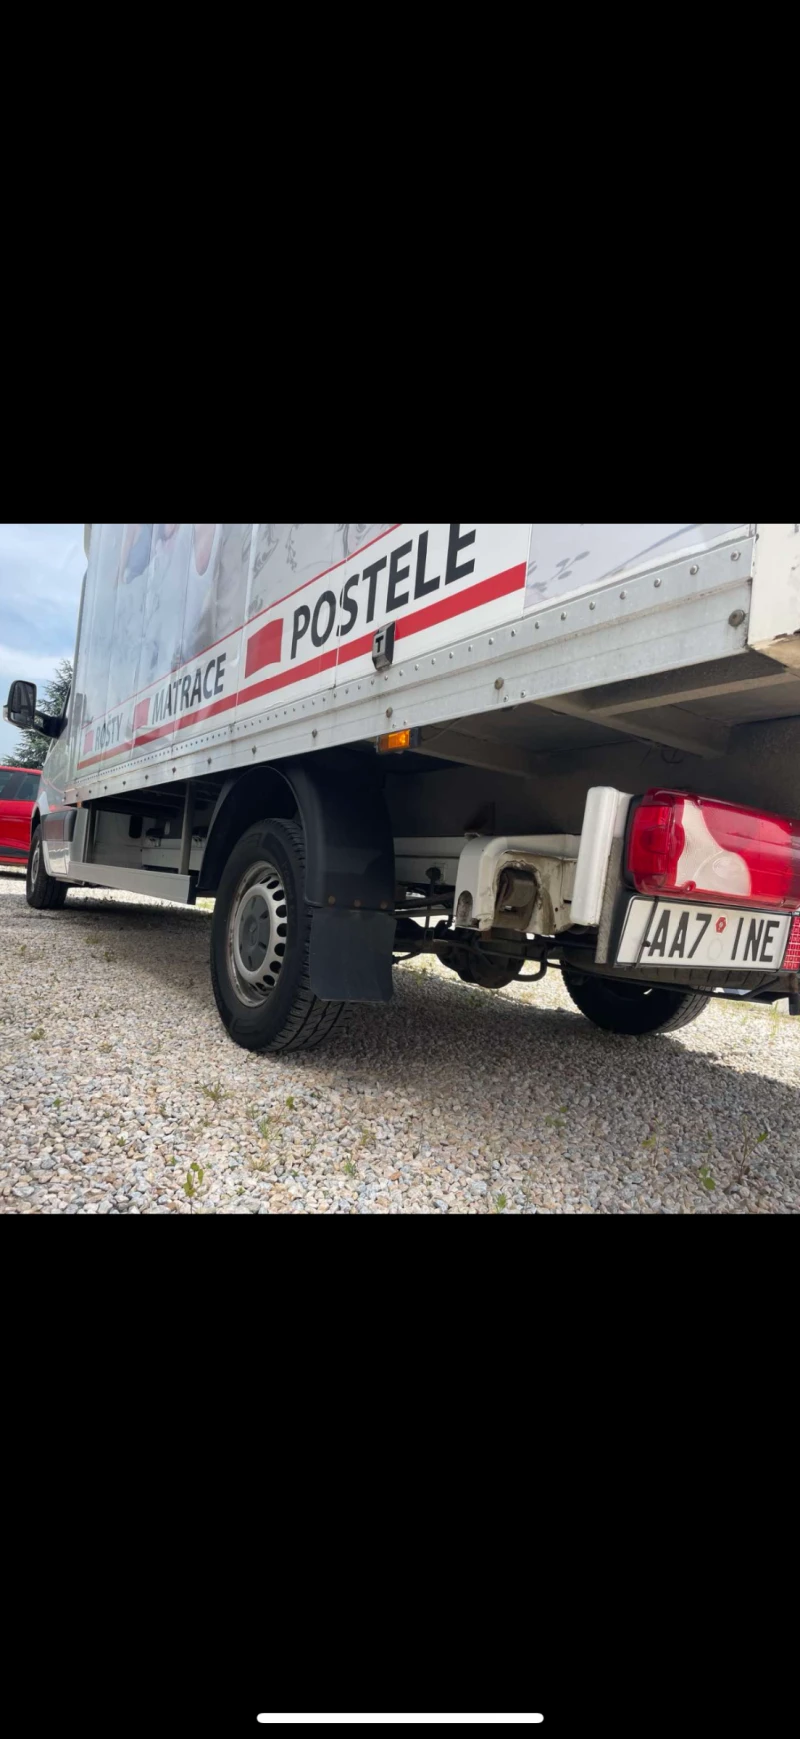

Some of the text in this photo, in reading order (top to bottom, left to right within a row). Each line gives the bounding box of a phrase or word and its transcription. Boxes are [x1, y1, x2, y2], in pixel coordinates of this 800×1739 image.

[290, 524, 476, 660] POSTELE
[152, 652, 226, 725] MATRACE
[95, 712, 123, 751] ROŠTY
